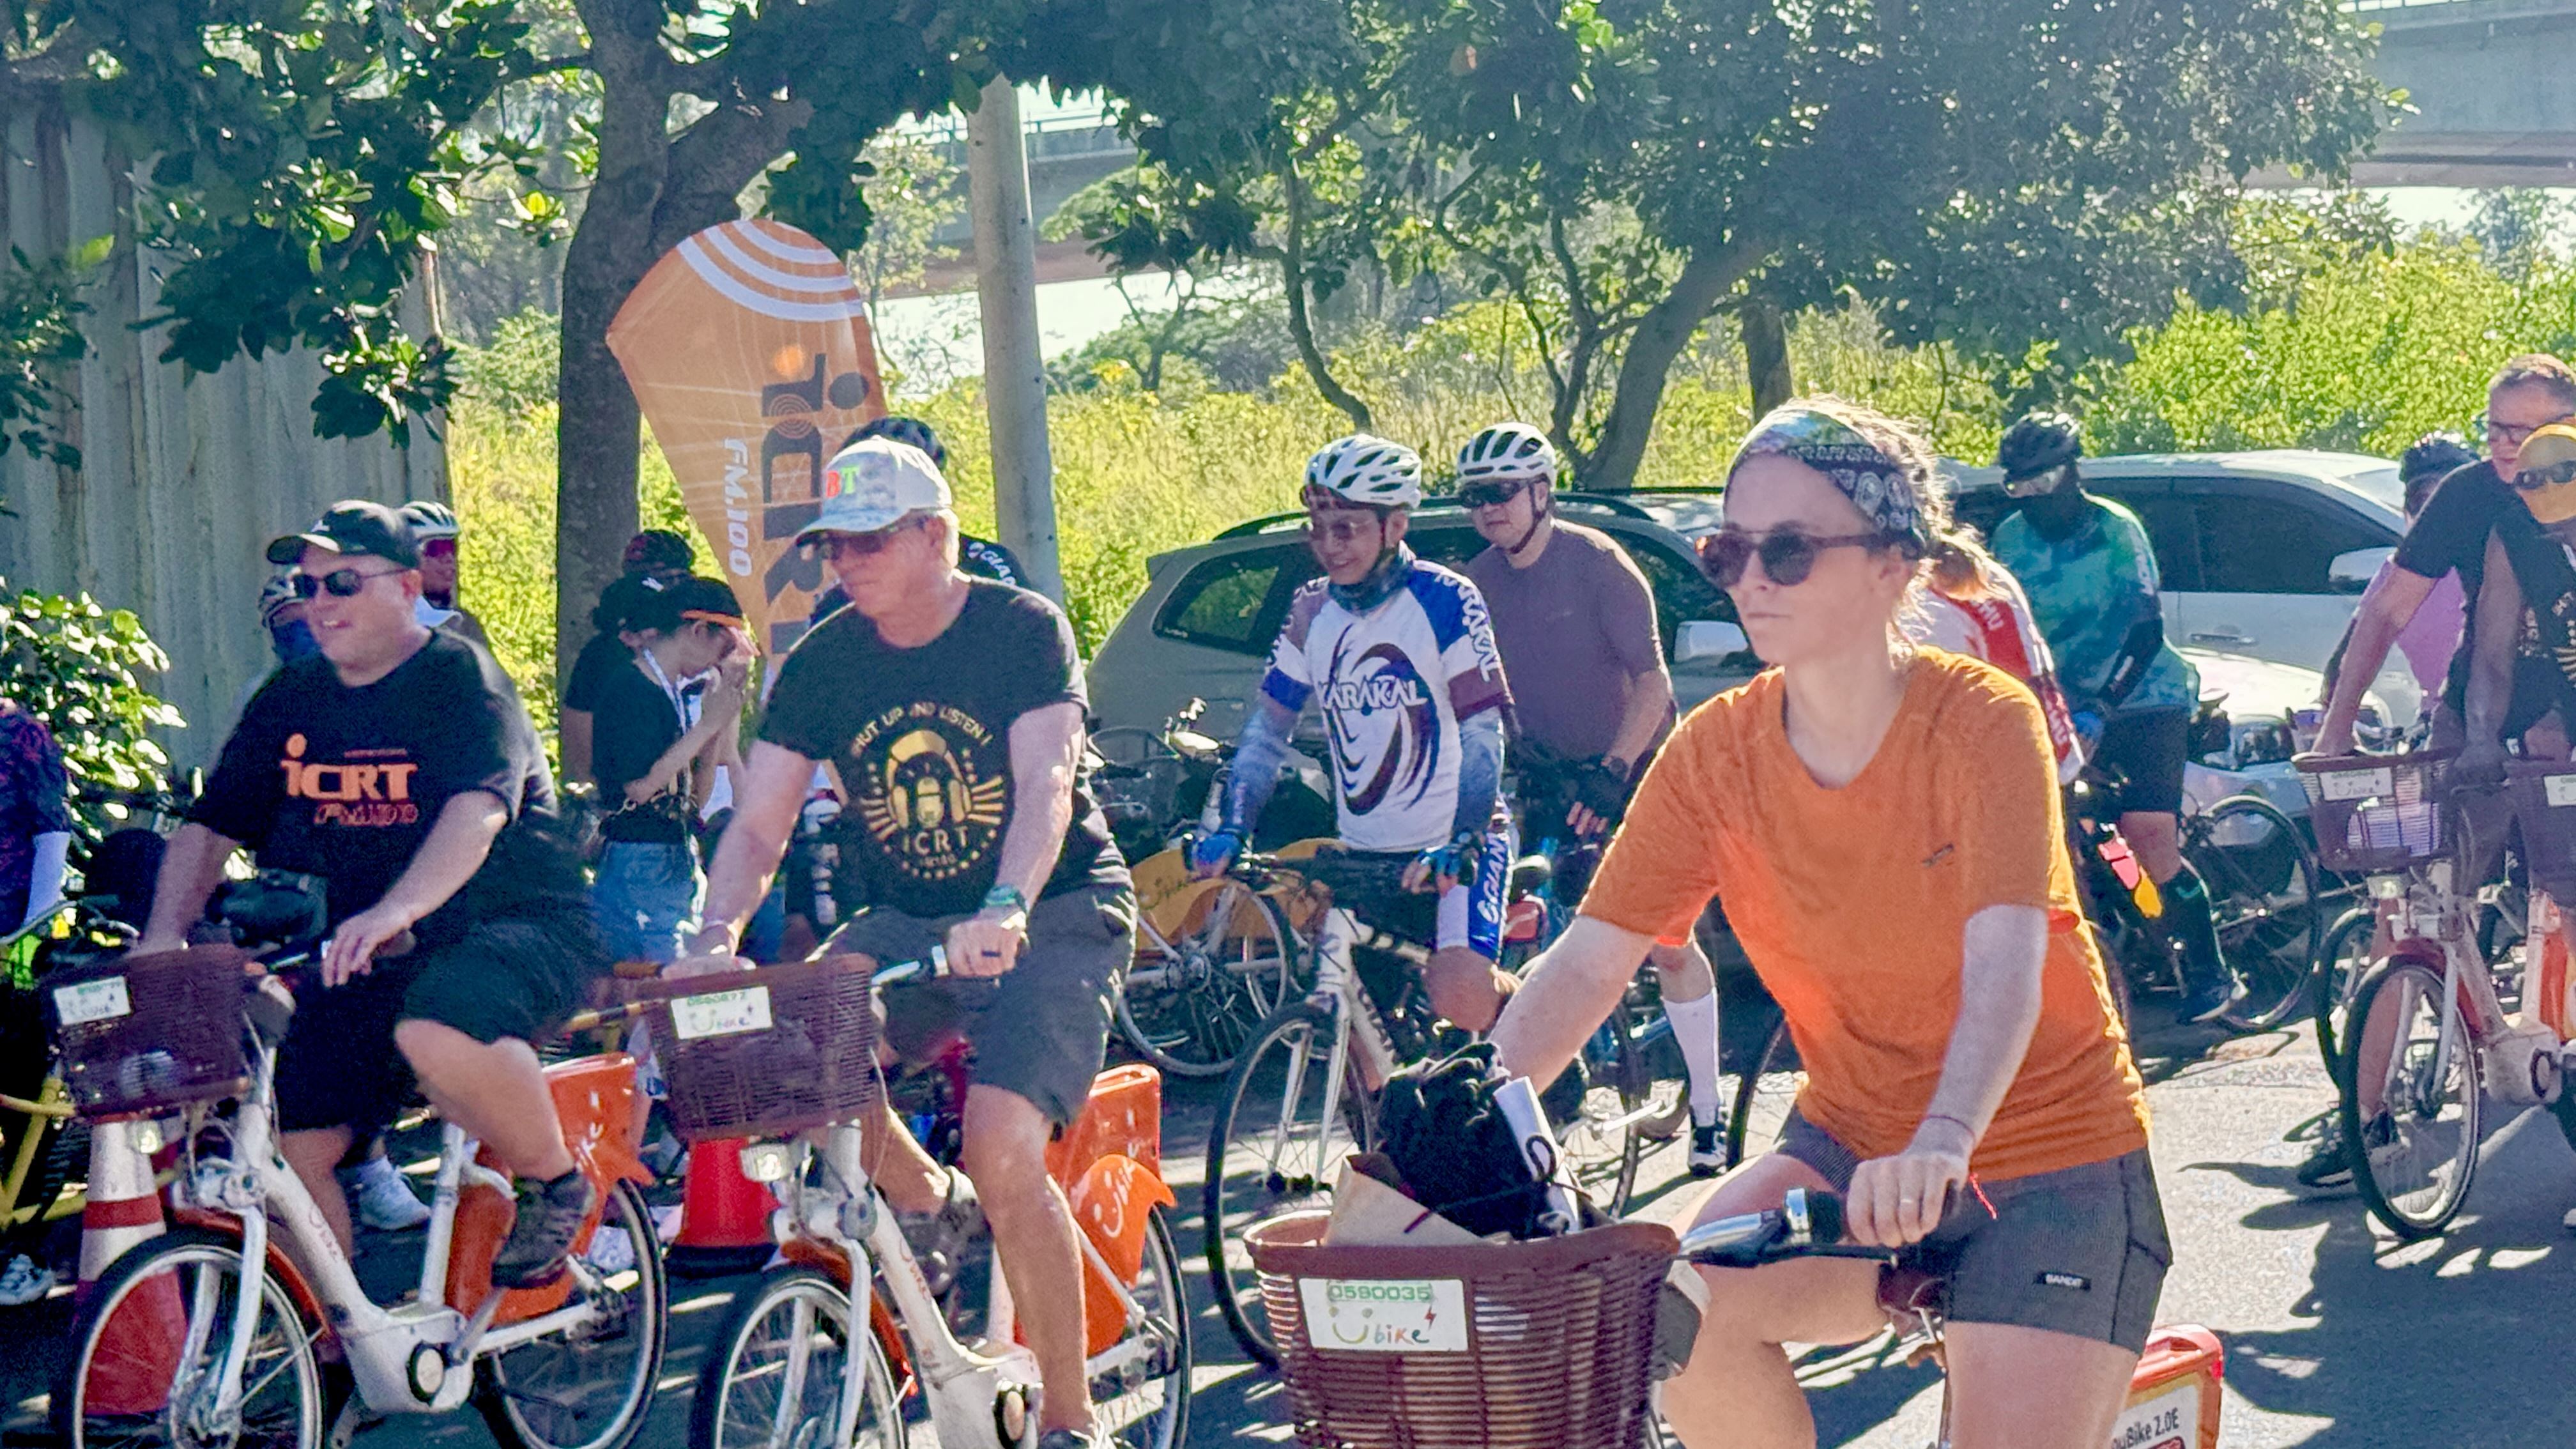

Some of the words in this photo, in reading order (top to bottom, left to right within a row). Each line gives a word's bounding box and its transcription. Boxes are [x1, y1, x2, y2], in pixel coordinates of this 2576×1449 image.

[1315, 675, 1429, 710] KARAKAL
[881, 707, 905, 726] UP
[903, 825, 969, 855] ICRT
[2153, 1407, 2180, 1437] 2.0E
